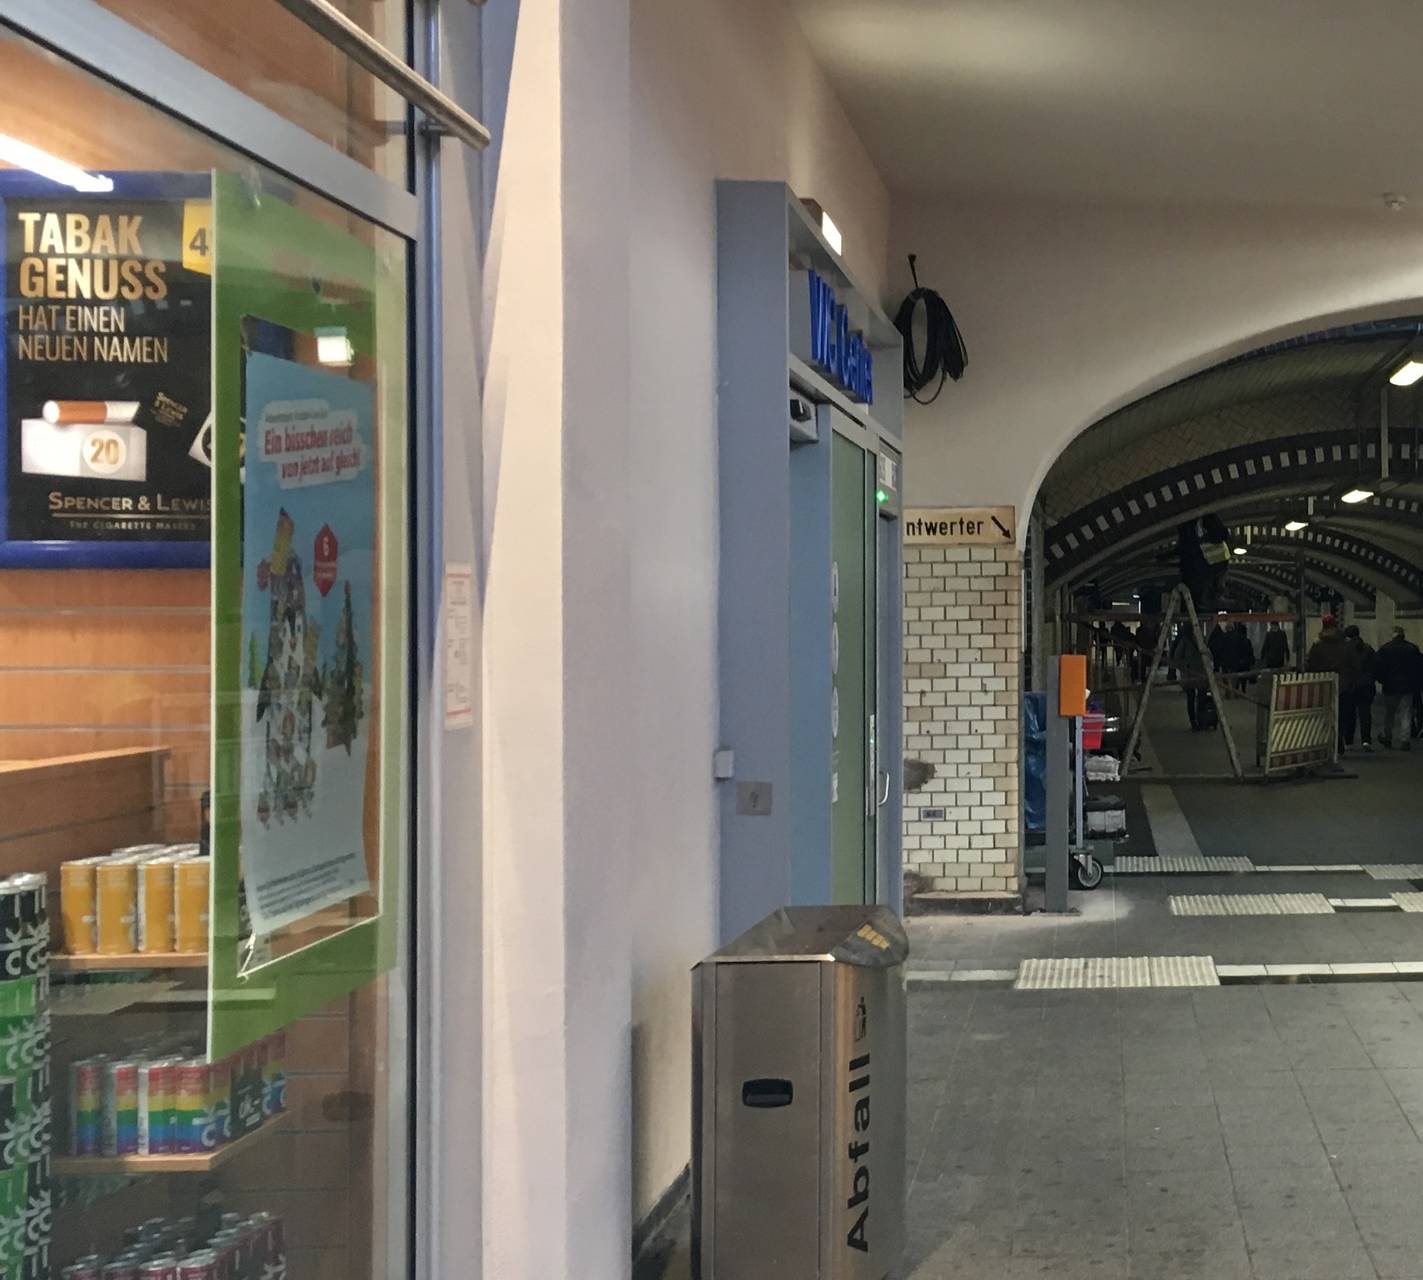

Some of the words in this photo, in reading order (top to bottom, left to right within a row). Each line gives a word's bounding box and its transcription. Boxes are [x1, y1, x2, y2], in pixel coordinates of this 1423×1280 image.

[18, 212, 143, 255] TABAK
[19, 257, 167, 300] GENUSS
[19, 305, 60, 332] HAT
[66, 307, 124, 333] EINEN
[18, 336, 88, 362] NEUEN
[94, 338, 168, 363] NAMEN
[90, 437, 120, 467] 20
[48, 491, 133, 511] SPENCER
[137, 495, 150, 511] &
[93, 521, 151, 530] CIGARETTE
[847, 1053, 871, 1252] Abfall
